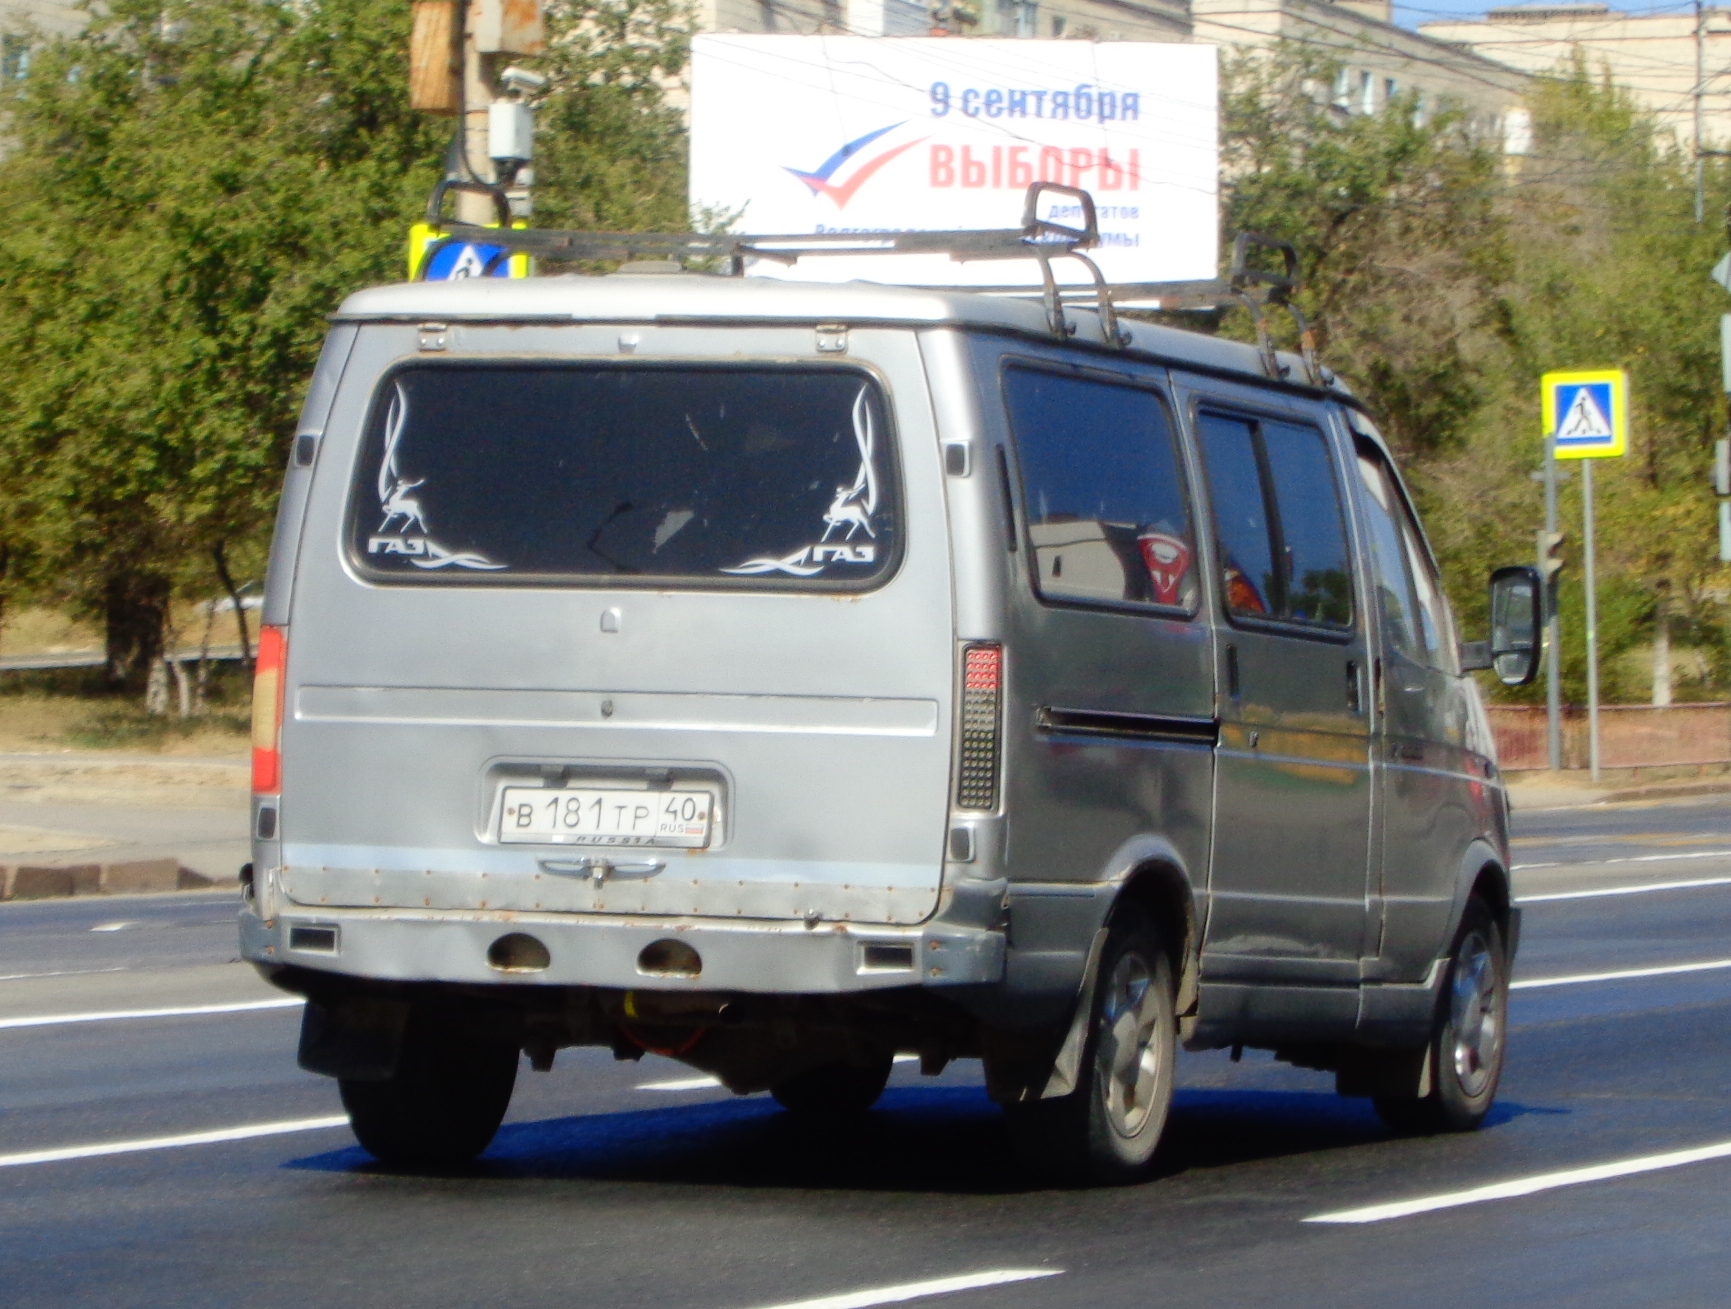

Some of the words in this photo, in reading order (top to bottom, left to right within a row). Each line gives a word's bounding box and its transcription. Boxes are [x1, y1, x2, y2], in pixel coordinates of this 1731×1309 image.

[930, 82, 950, 116] 9
[962, 82, 1140, 123] сентября
[929, 144, 1140, 191] ВЫБОРЫ
[368, 537, 425, 554] ГАЗ
[813, 545, 875, 562] ГАЗ
[665, 797, 696, 822] 40
[660, 823, 684, 833] RUS
